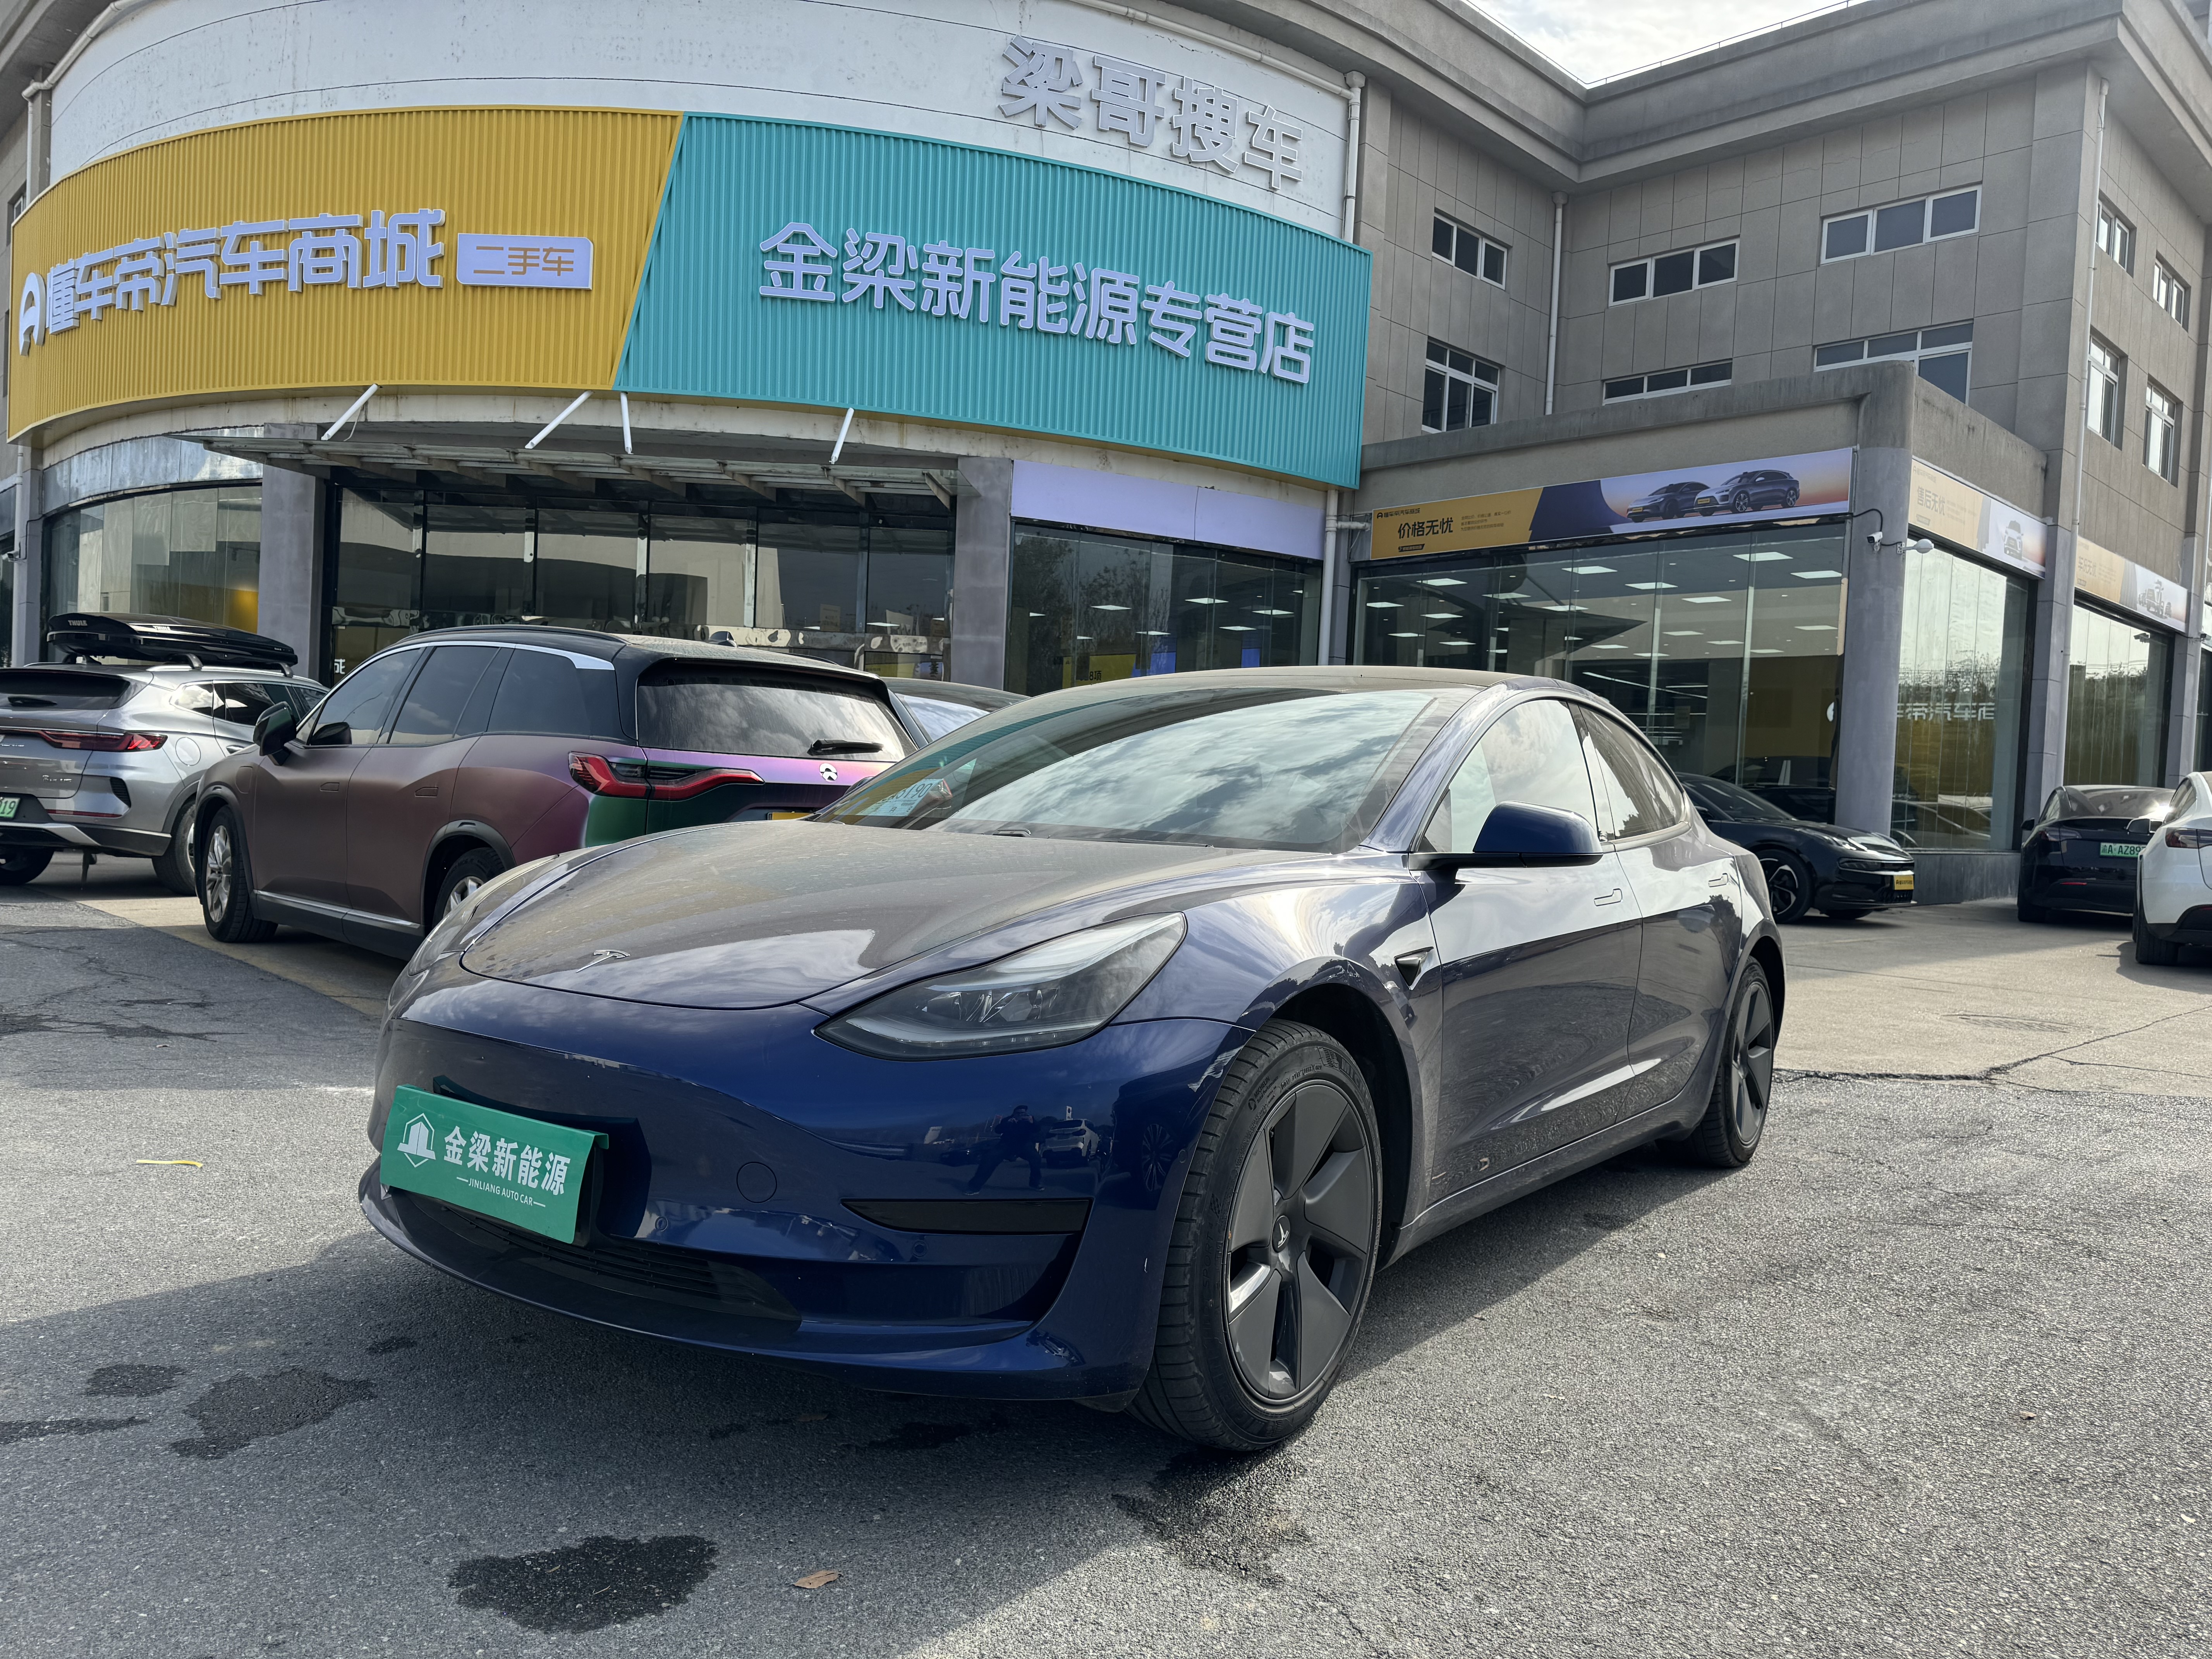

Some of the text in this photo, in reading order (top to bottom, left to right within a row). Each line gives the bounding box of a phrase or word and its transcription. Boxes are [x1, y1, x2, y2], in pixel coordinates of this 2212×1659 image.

[999, 34, 1304, 190] 梁哥搜车
[47, 208, 445, 335] 懂车帝汽车商城
[473, 246, 575, 276] 二手车
[759, 222, 1314, 384] 金梁新能源专营店
[1398, 517, 1453, 539] 价格无忧
[0, 800, 16, 815] 19
[1254, 1076, 1270, 1099] MICHELIN
[444, 1126, 570, 1195] 金梁新能源
[469, 1178, 533, 1206] JINLIANG AUTO CAR
[1202, 1234, 1213, 1288] SPORT
